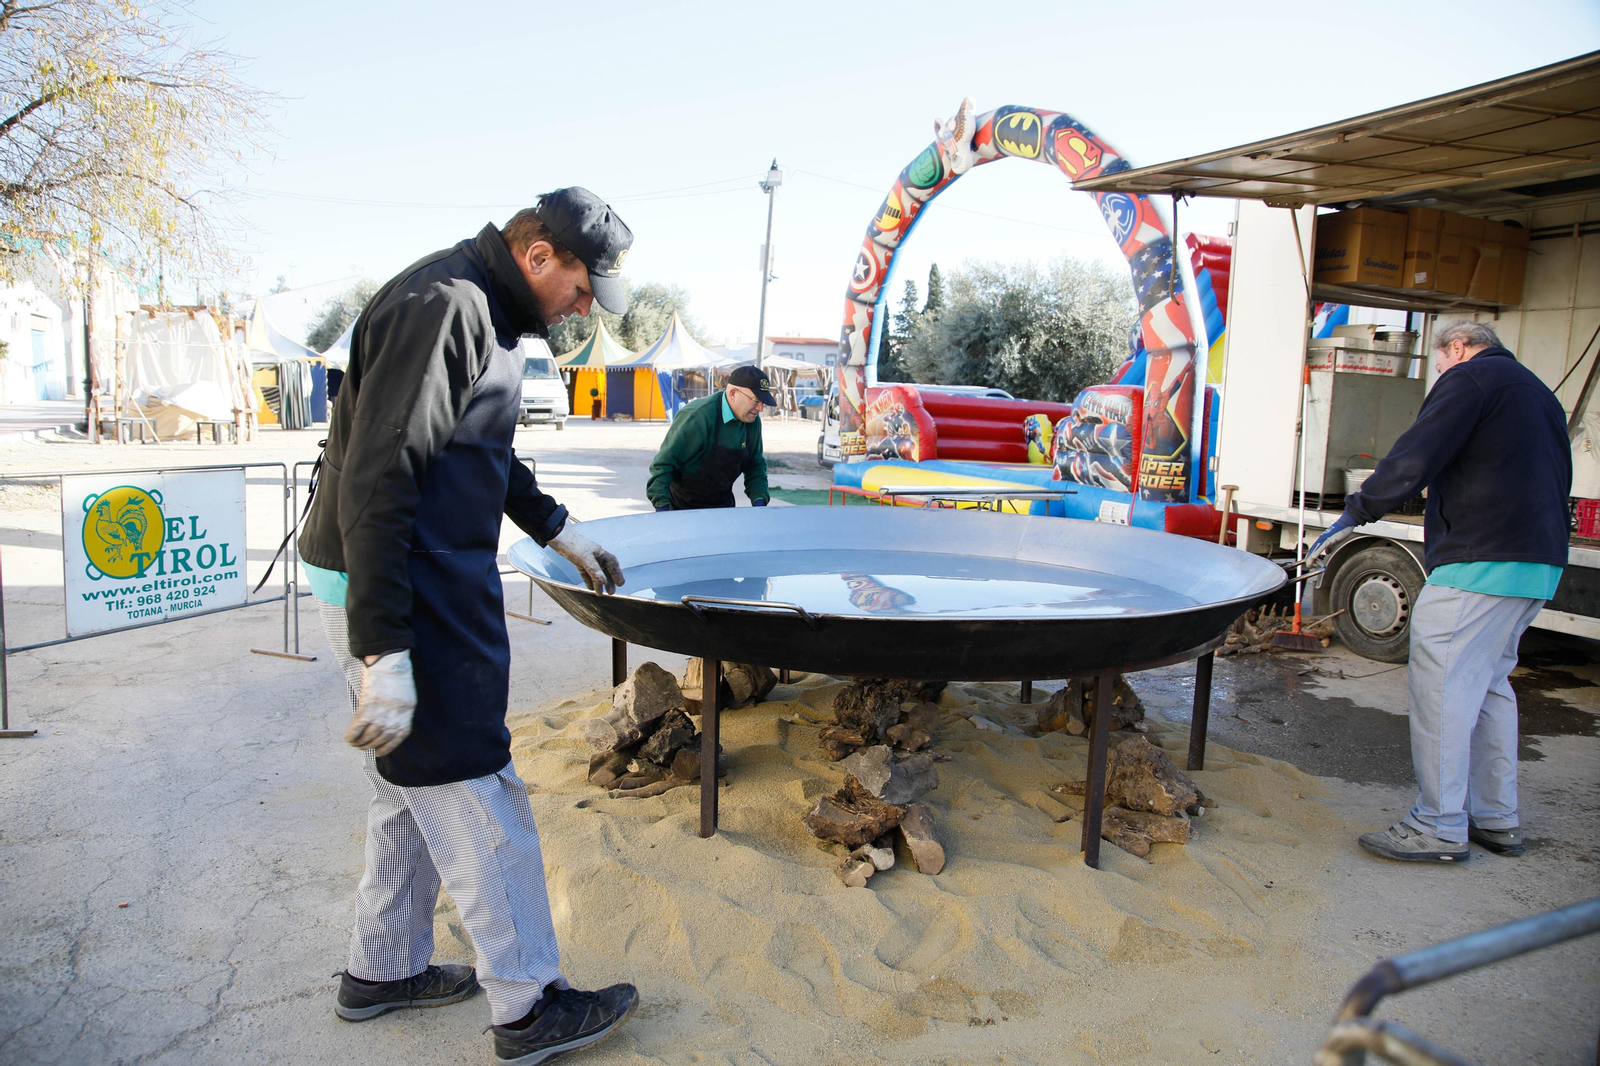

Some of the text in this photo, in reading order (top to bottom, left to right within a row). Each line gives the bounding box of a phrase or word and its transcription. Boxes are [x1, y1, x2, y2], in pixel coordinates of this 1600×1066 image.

[1139, 473, 1187, 490] ROES
[165, 516, 207, 542] EL
[130, 543, 237, 578] TIROL
[82, 570, 238, 601] www.eltirol.com
[105, 585, 216, 612] Tlf.: 968 420 924
[127, 608, 163, 620] TOTANA
[170, 599, 203, 612] MURCIA
